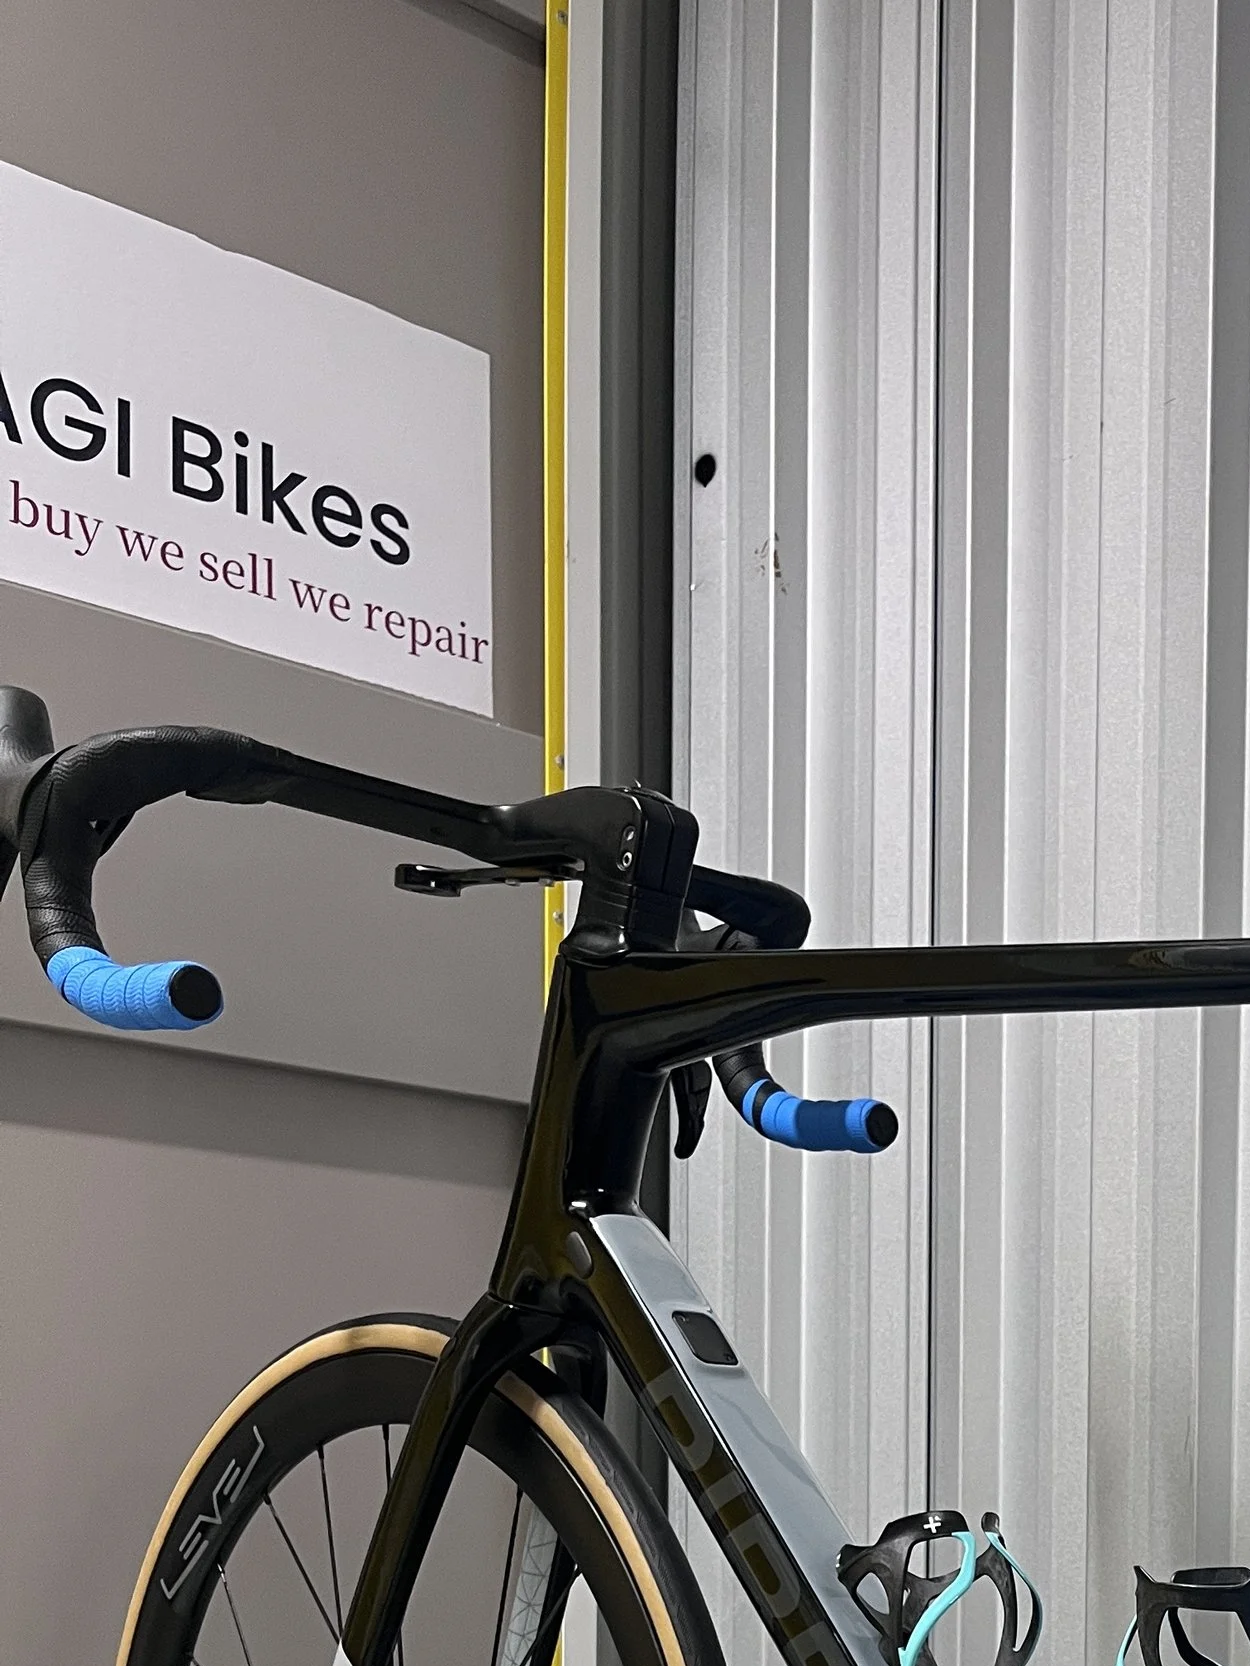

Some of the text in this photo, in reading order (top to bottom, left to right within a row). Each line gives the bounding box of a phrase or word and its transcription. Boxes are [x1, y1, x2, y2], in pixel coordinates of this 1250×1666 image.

[9, 479, 489, 664] buy we sell we repair
[171, 415, 411, 566] Bikes
